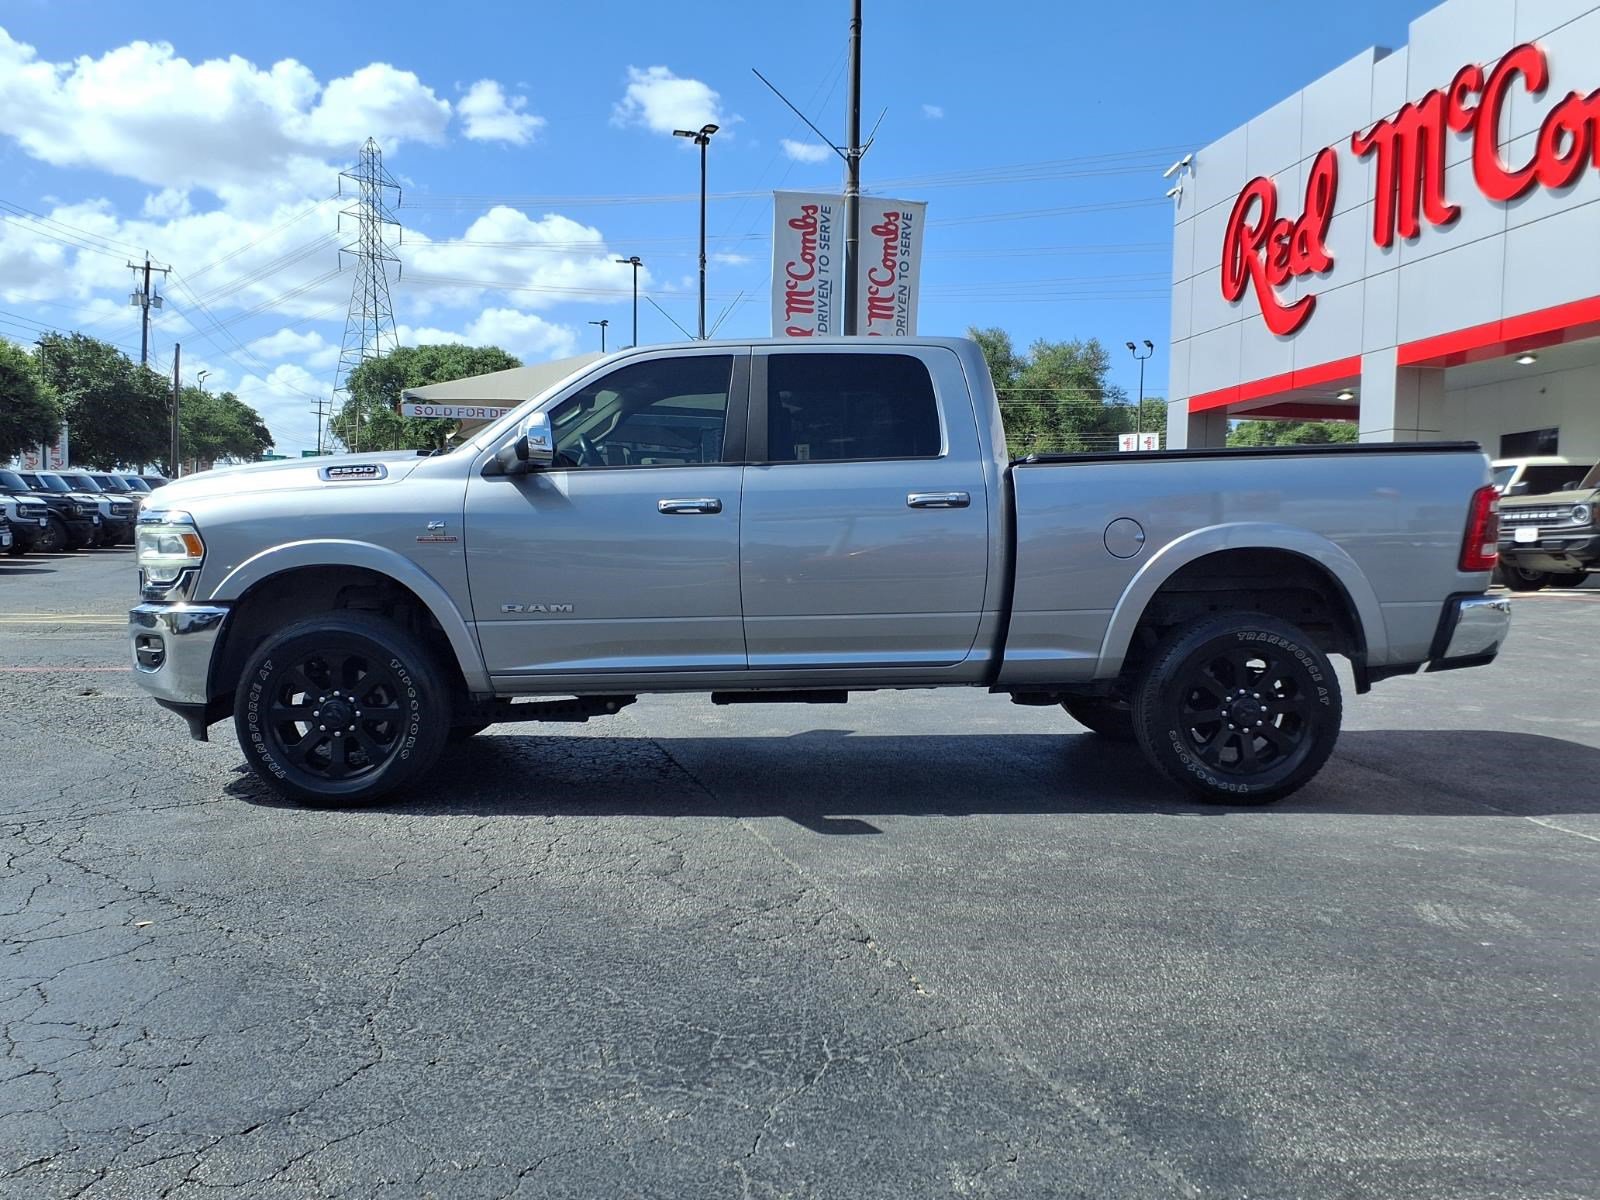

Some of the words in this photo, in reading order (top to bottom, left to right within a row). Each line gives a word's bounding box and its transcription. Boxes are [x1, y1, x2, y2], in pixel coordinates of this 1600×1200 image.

[819, 205, 832, 250] SERVE
[901, 211, 913, 256] SERVE
[1220, 148, 1338, 336] Red
[785, 205, 818, 321] McCombs
[819, 255, 830, 274] TO
[867, 211, 900, 327] McCombs
[899, 261, 910, 280] TO
[818, 280, 830, 336] DRIVEN
[896, 286, 908, 336] DRIVEN
[414, 406, 452, 417] SOLD
[457, 408, 485, 418] FOR
[501, 604, 573, 613] RAM
[259, 659, 273, 681] AT
[1237, 631, 1323, 682] TRANSFORCE
[248, 683, 287, 779] TRANSFORCE
